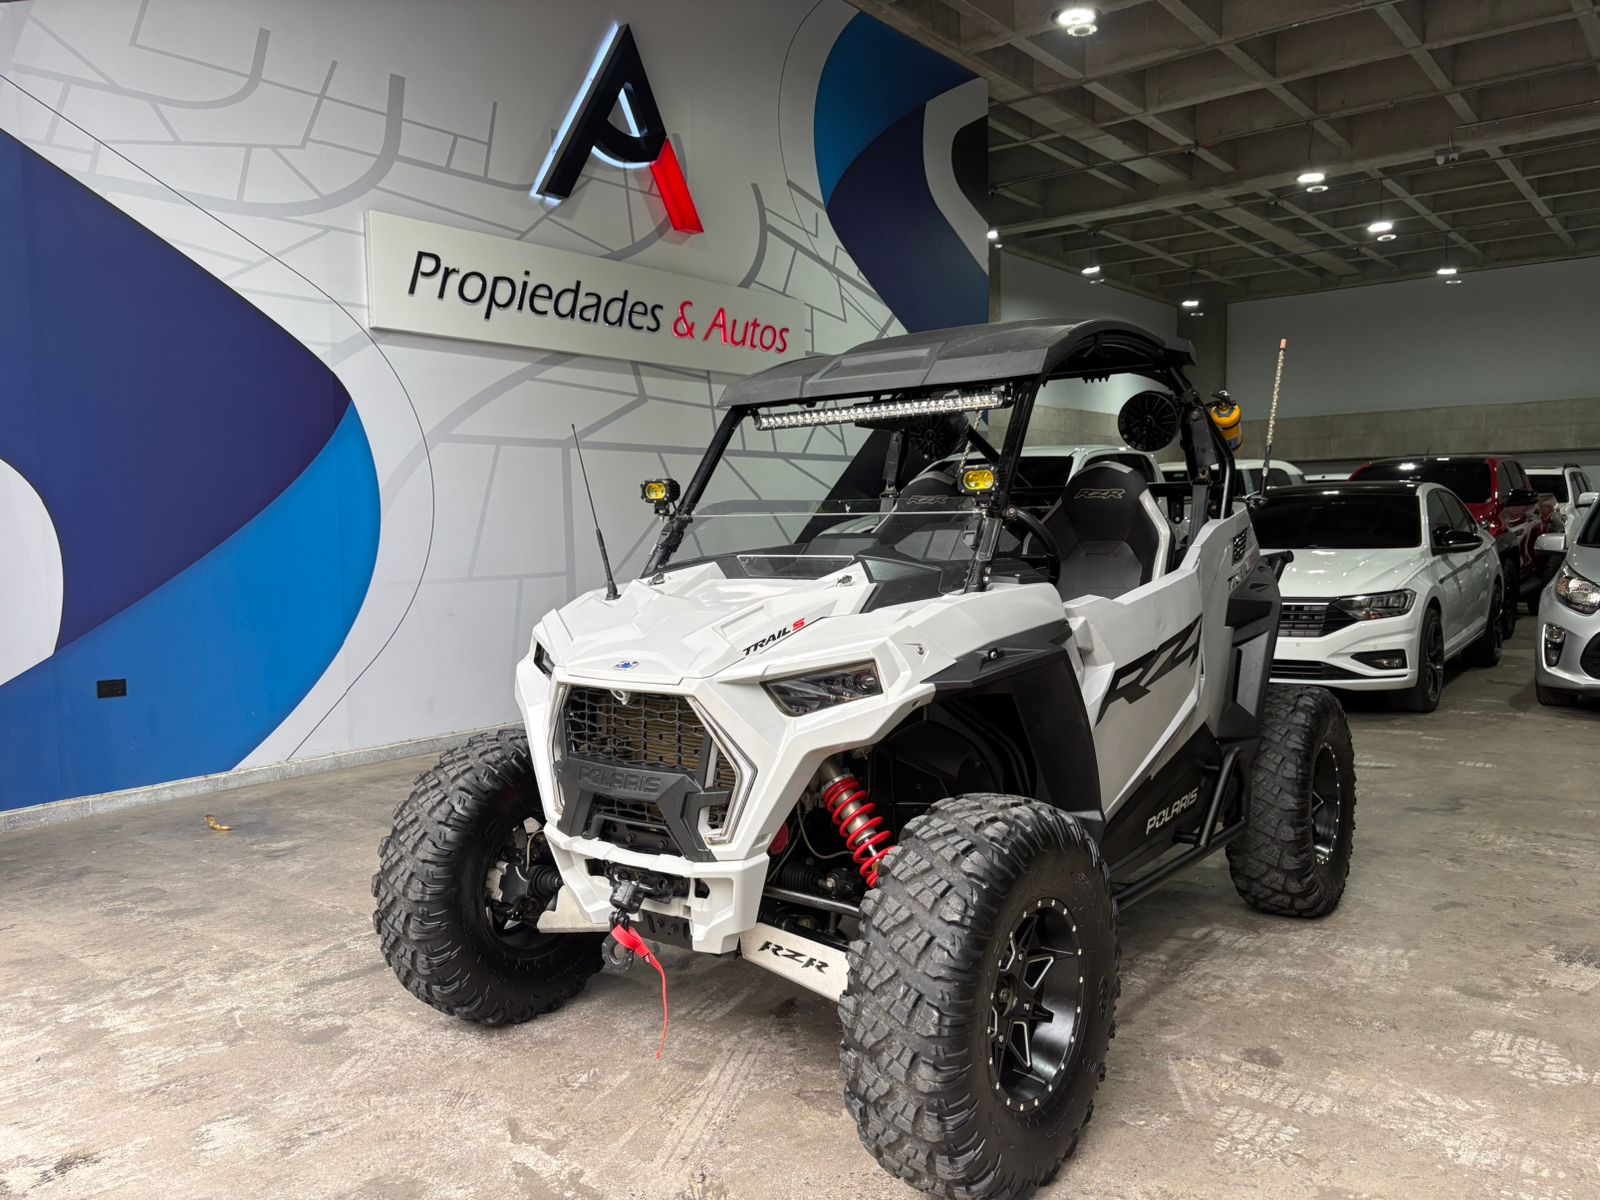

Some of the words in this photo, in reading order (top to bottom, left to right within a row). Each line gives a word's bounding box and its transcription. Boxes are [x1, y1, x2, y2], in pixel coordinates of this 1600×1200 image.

[407, 250, 664, 333] Propiedades
[671, 300, 696, 339] &
[702, 306, 791, 354] Autos
[1072, 488, 1126, 500] RZR
[742, 627, 791, 656] TRAIL
[792, 617, 806, 631] S
[578, 765, 662, 793] POLARIS
[1145, 787, 1199, 836] POLARIS
[758, 940, 831, 975] RZR
